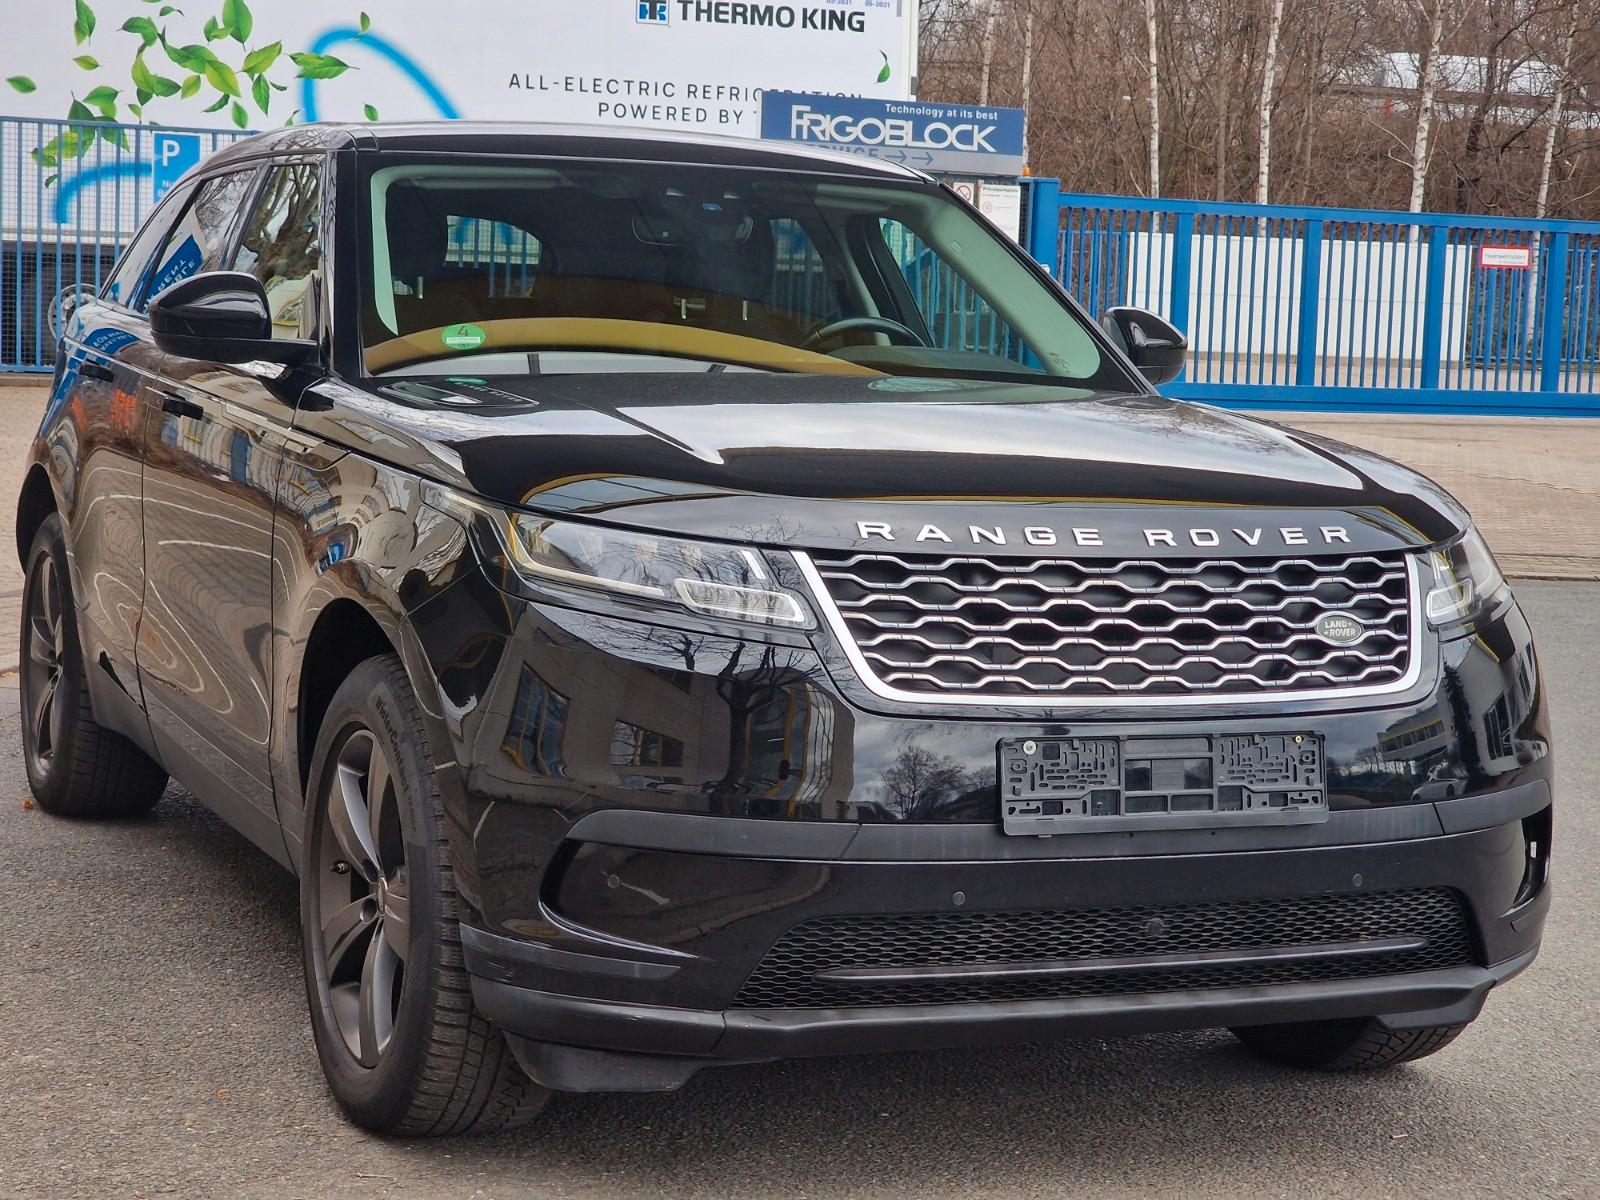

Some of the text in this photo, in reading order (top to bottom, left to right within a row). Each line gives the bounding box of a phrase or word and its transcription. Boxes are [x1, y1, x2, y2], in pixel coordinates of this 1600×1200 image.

[677, 0, 865, 33] THERMO KING
[508, 73, 676, 98] ALL-ELECTRIC
[598, 102, 744, 125] POWERED BY
[885, 103, 998, 120] Technology at its best
[791, 104, 997, 153] FRIGOBLOCK
[162, 139, 180, 167] P
[457, 325, 470, 337] 4
[856, 520, 1352, 547] RANGE ROVER
[1324, 620, 1347, 629] LAND
[1329, 628, 1356, 637] ROVER
